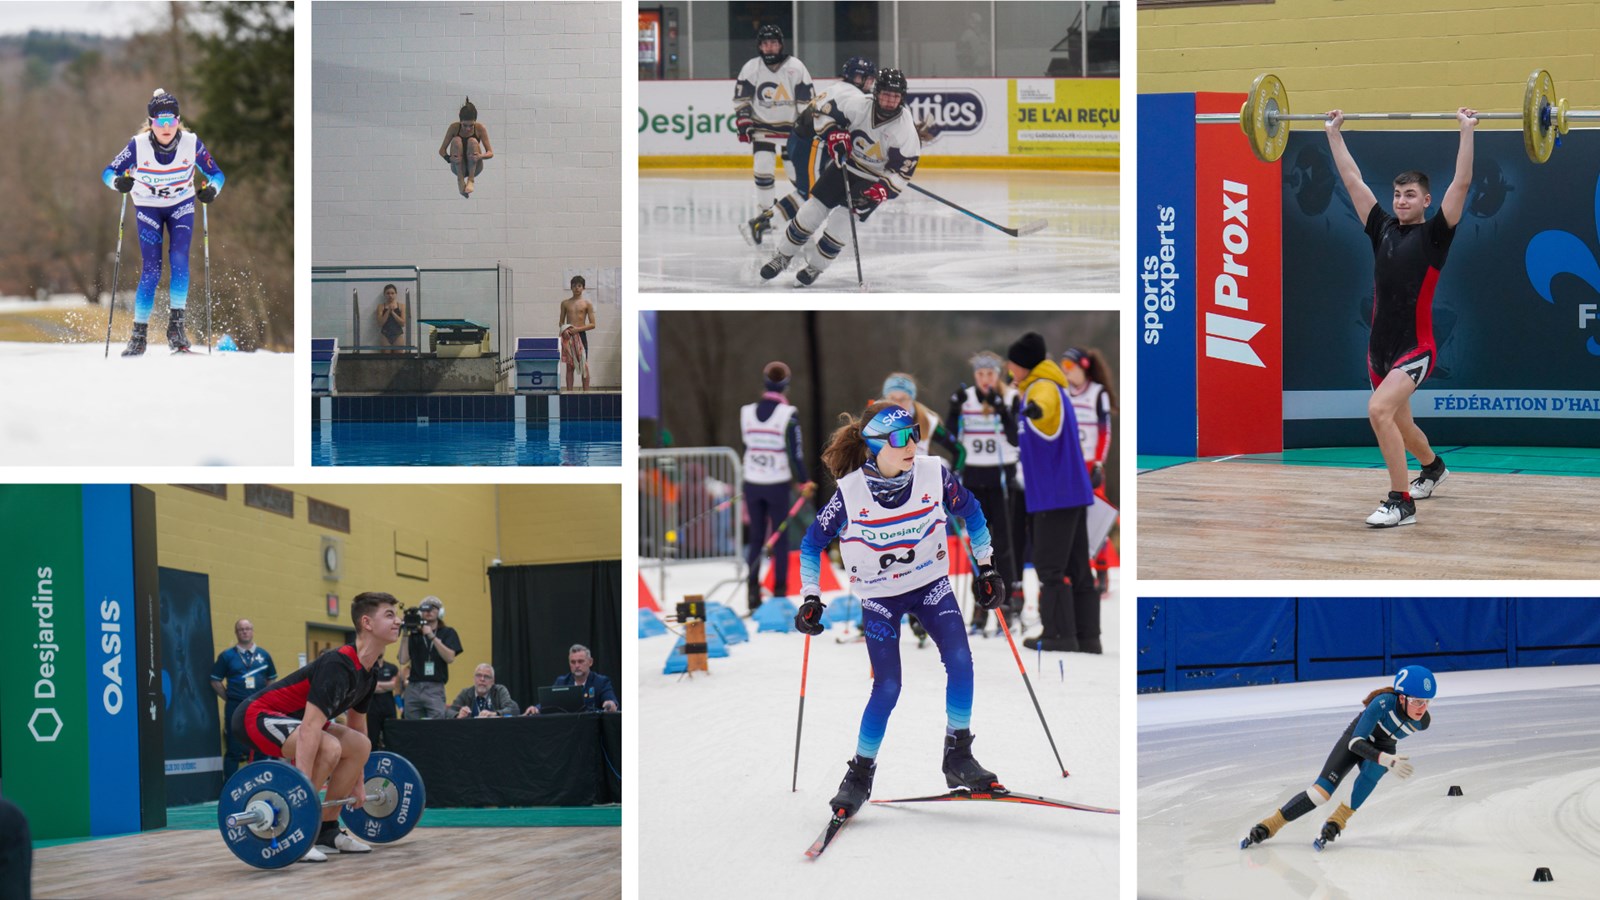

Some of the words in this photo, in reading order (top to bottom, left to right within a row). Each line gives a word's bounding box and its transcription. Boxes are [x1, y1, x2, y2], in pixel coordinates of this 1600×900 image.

[1018, 108, 1037, 122] JE
[1043, 108, 1072, 122] L'AI
[1077, 108, 1120, 128] REÇU
[1215, 179, 1249, 312] Proxi
[1156, 206, 1180, 312] experts
[1140, 255, 1163, 345] sports
[1578, 303, 1597, 329] F
[531, 371, 543, 385] 8
[1433, 394, 1548, 411] FÉDÉRATION
[1551, 396, 1600, 412] D'HAL
[972, 438, 997, 454] 98
[880, 519, 930, 540] Desjard
[32, 566, 59, 698] Desjardins
[100, 600, 123, 715] OASIS
[1395, 669, 1408, 692] 2
[289, 789, 308, 805] 20
[397, 782, 414, 825] ELEIKO
